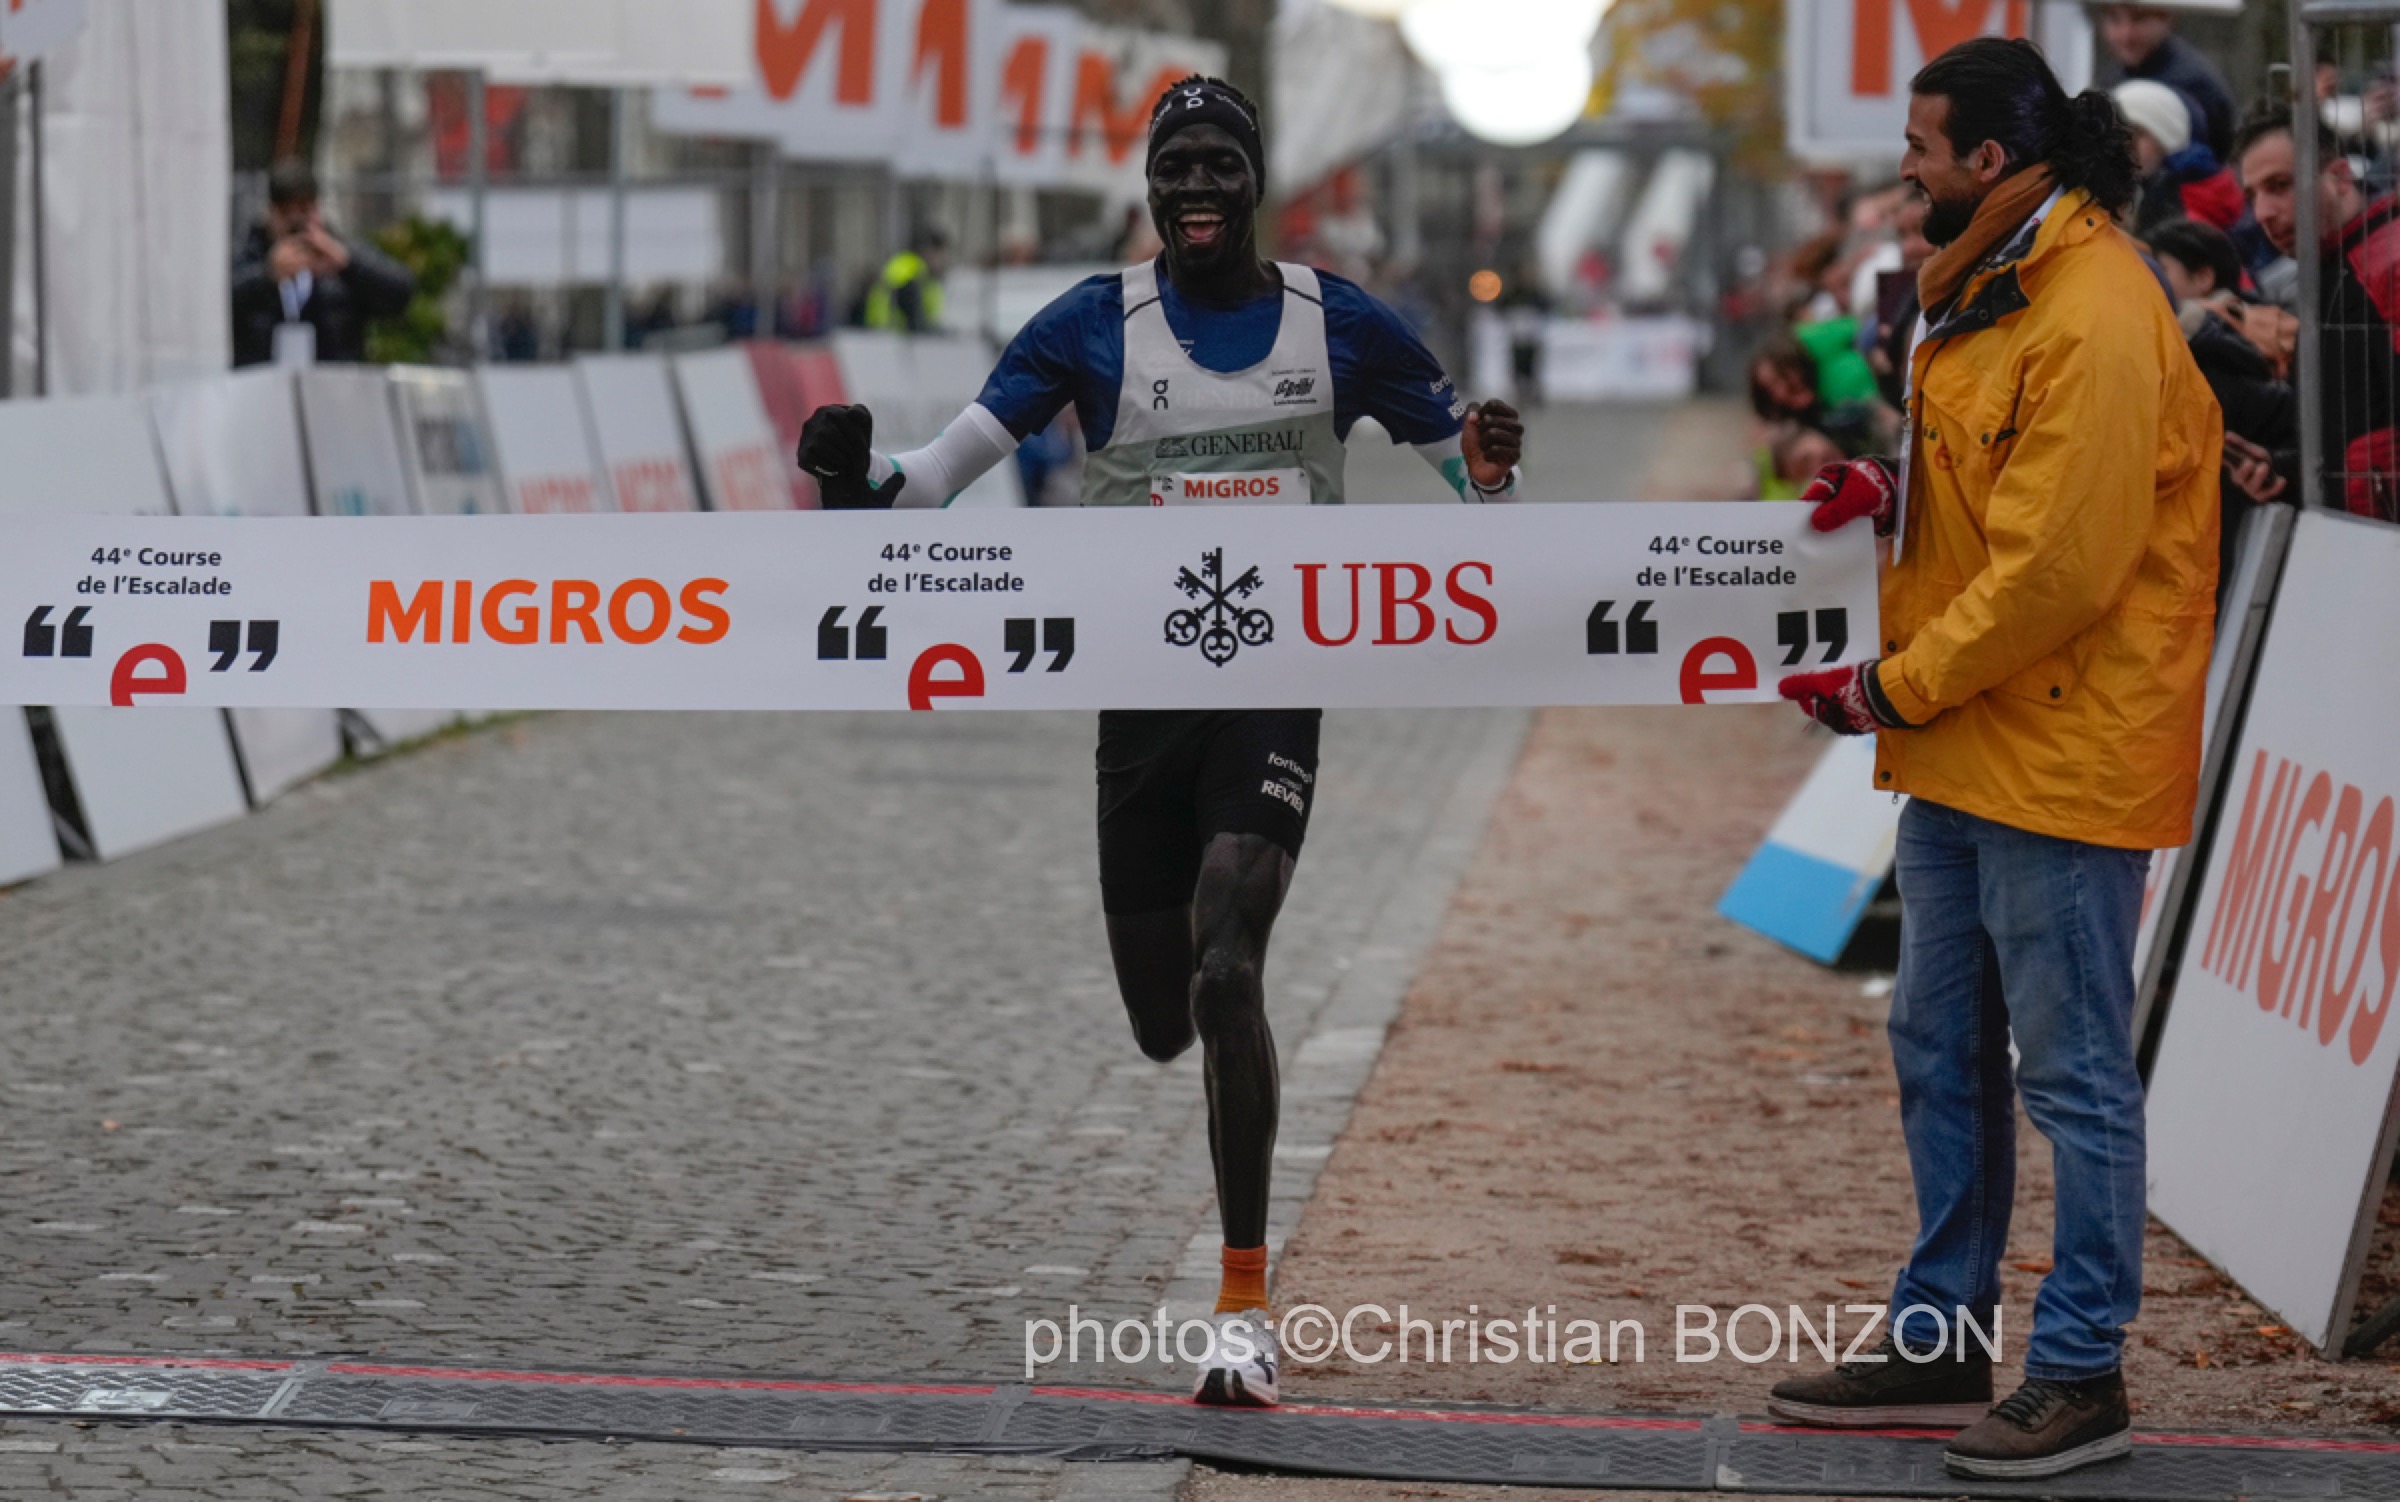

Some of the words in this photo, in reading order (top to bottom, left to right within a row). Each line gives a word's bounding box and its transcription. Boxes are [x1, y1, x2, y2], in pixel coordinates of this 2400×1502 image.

[1190, 430, 1305, 458] GENERALI
[1183, 475, 1281, 500] MIGROS
[137, 546, 222, 568] Course
[927, 542, 1013, 563] Course
[1697, 535, 1787, 556] Course
[77, 574, 107, 596] de
[867, 573, 898, 594] de
[1635, 565, 1667, 588] de
[366, 577, 731, 646] MIGROS
[1293, 561, 1499, 647] UBS
[2201, 748, 2400, 1067] MIGROS
